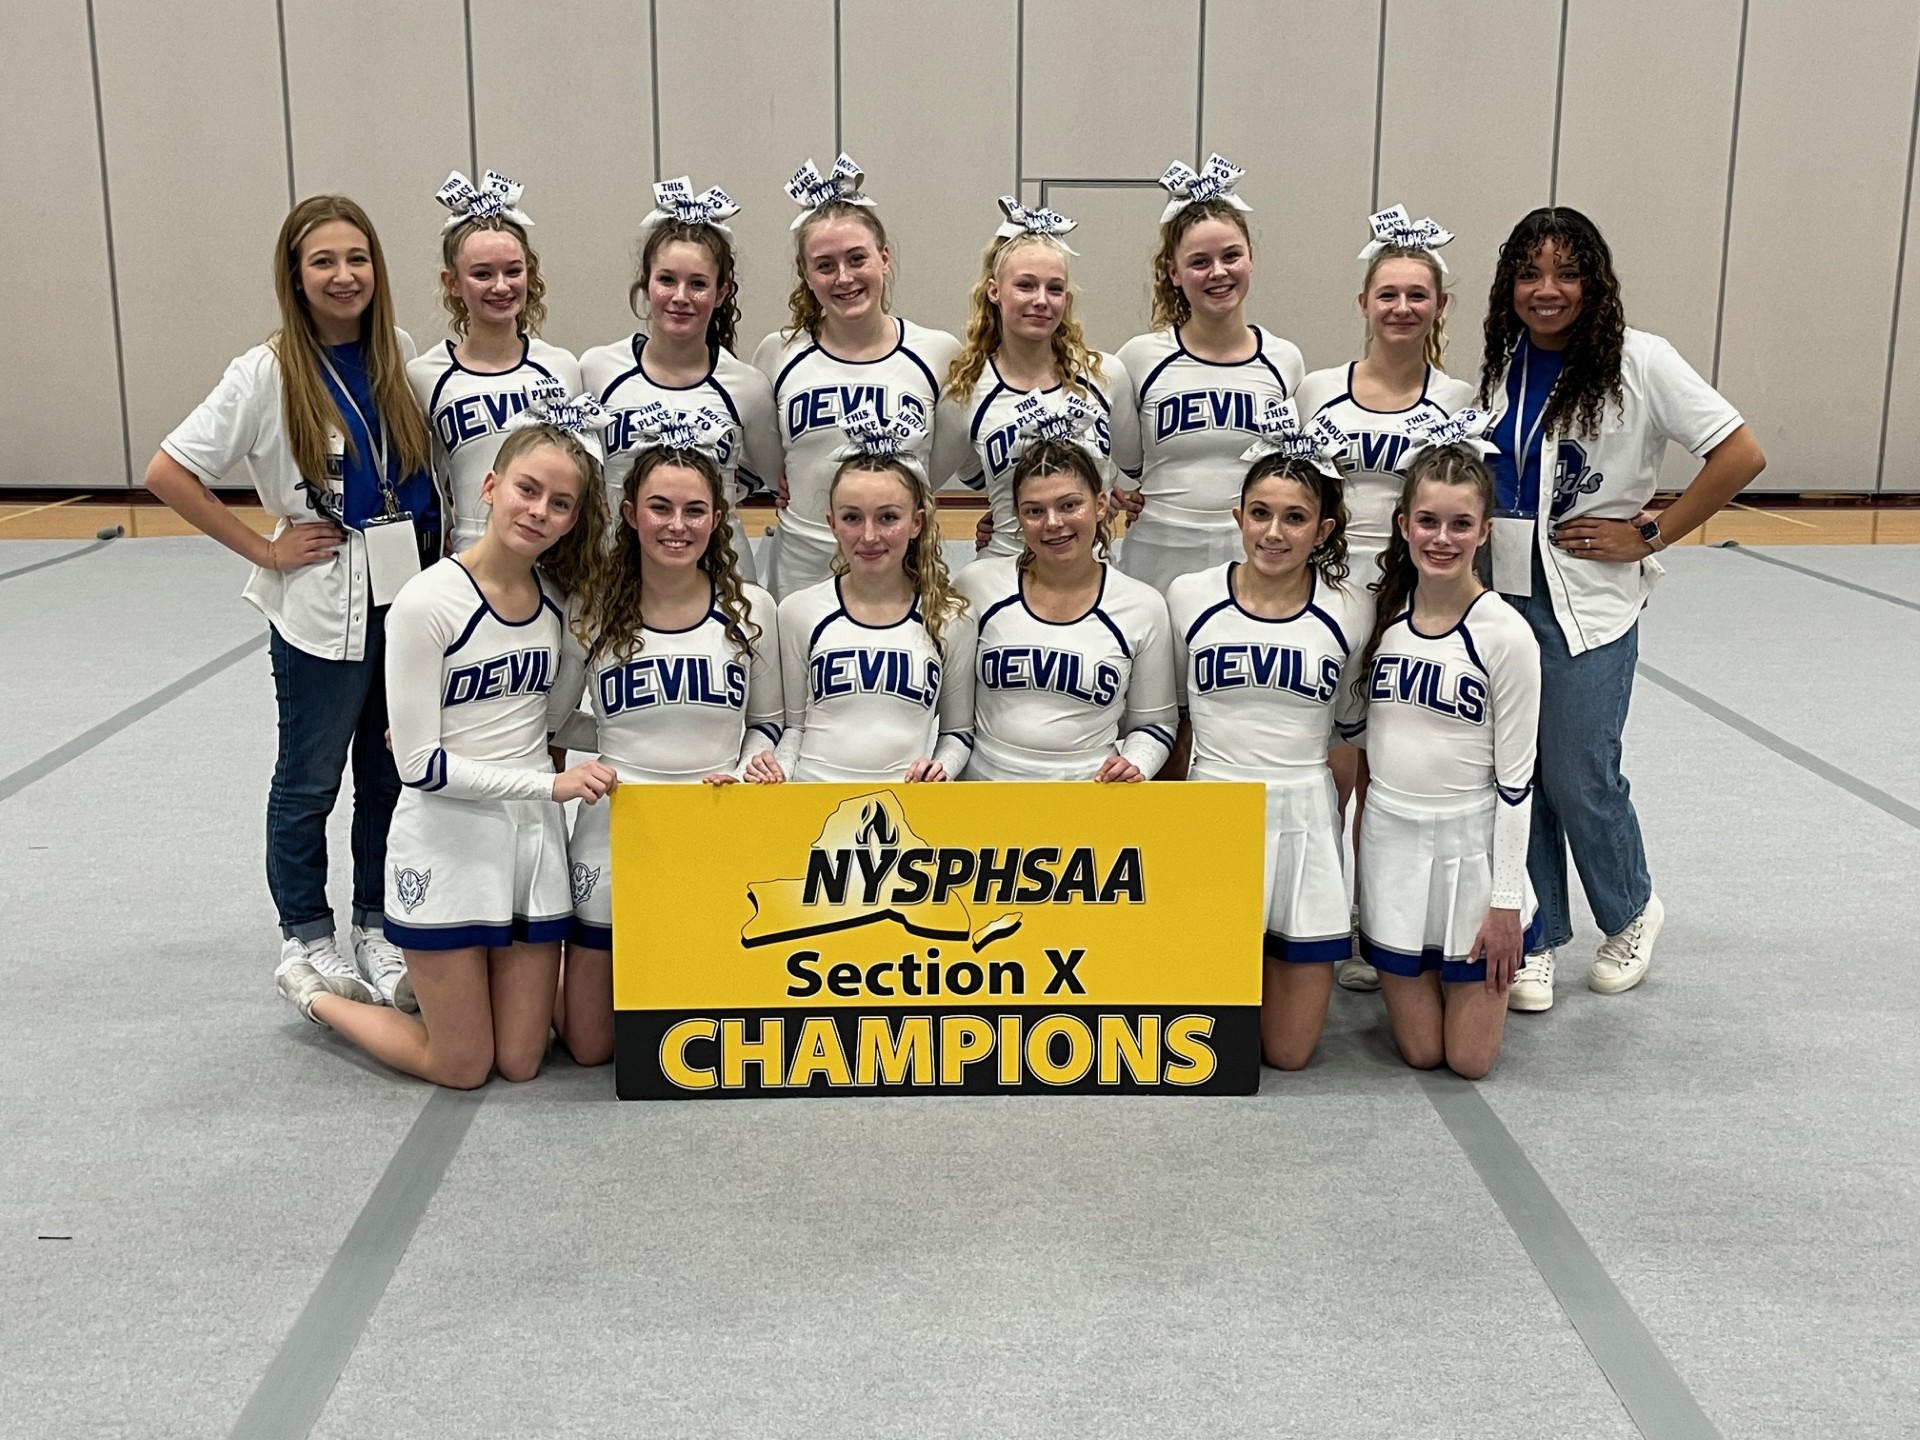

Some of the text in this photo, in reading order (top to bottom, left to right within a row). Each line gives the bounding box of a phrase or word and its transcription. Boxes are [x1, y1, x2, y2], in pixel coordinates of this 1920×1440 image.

[1212, 166, 1229, 178] TO
[443, 178, 461, 193] THIS
[446, 184, 472, 206] PLACE
[492, 181, 509, 193] TO
[661, 182, 684, 192] THIS
[790, 172, 817, 199] PLACE
[707, 197, 722, 209] TO
[1376, 211, 1399, 222] THIS
[531, 387, 566, 400] PLACE
[640, 400, 662, 416] THIS
[1014, 396, 1038, 413] THIS
[1067, 406, 1084, 419] TO
[1264, 406, 1289, 420] THIS
[638, 410, 672, 430] PLACE
[694, 416, 711, 431] TO
[698, 406, 729, 428] ABOUT
[845, 409, 870, 425] THIS
[897, 411, 925, 433] ABOUT
[1016, 406, 1048, 427] PLACE
[1155, 389, 1278, 444] DEVIL
[1261, 418, 1296, 434] PLACE
[1405, 412, 1431, 426] THIS
[845, 420, 878, 439] PLACE
[893, 422, 910, 438] TO
[1314, 427, 1329, 446] TO
[1316, 414, 1349, 446] ABOUT
[442, 647, 554, 708] DEVIL
[810, 648, 942, 709] DEVILS
[981, 646, 1121, 707] DEVILS
[1194, 644, 1341, 704] DEVILS
[598, 655, 747, 717] DEVILS
[1369, 655, 1487, 725] EVILS
[801, 845, 1146, 906] NYSPHSAA
[786, 949, 1087, 996] Section X
[659, 1013, 1218, 1089] CHAMPIONS
